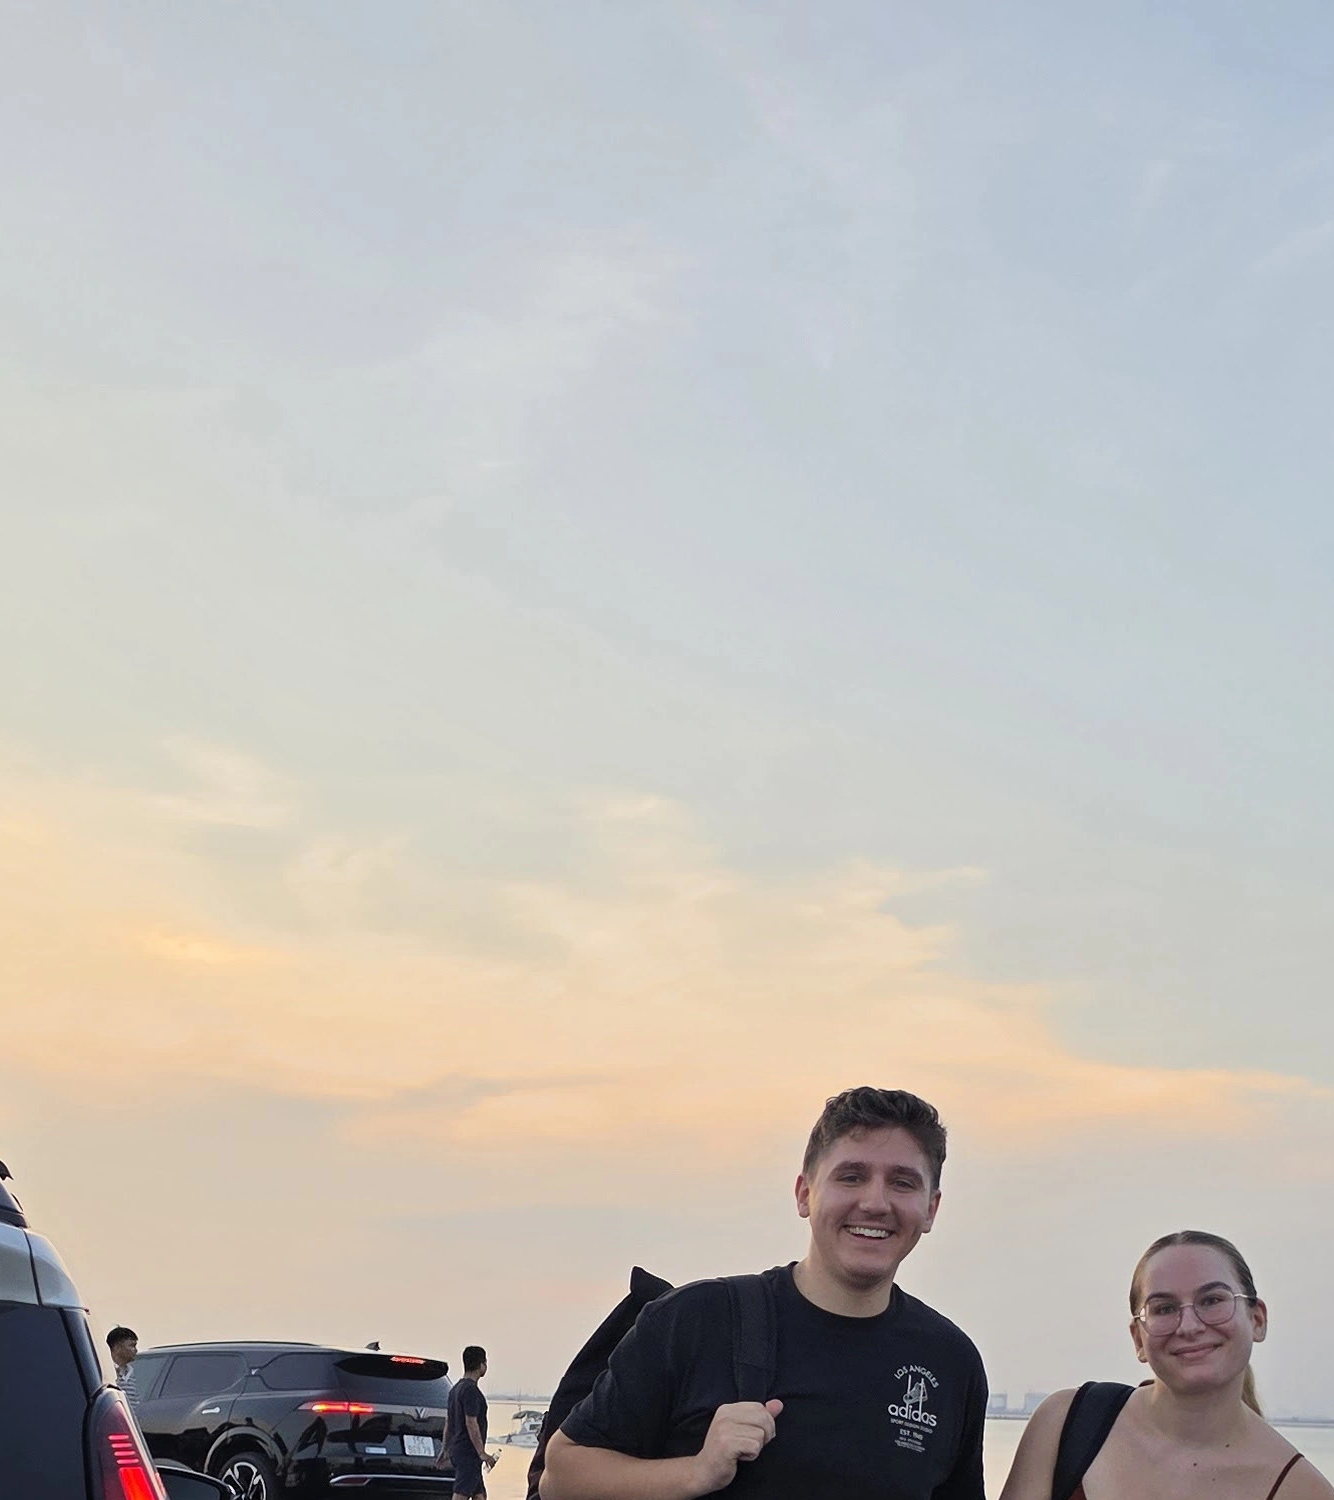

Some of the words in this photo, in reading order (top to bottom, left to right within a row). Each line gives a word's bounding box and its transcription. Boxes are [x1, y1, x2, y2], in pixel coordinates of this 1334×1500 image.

[893, 1365, 908, 1380] LOS
[909, 1364, 939, 1388] ANGELES
[887, 1403, 937, 1427] adidas
